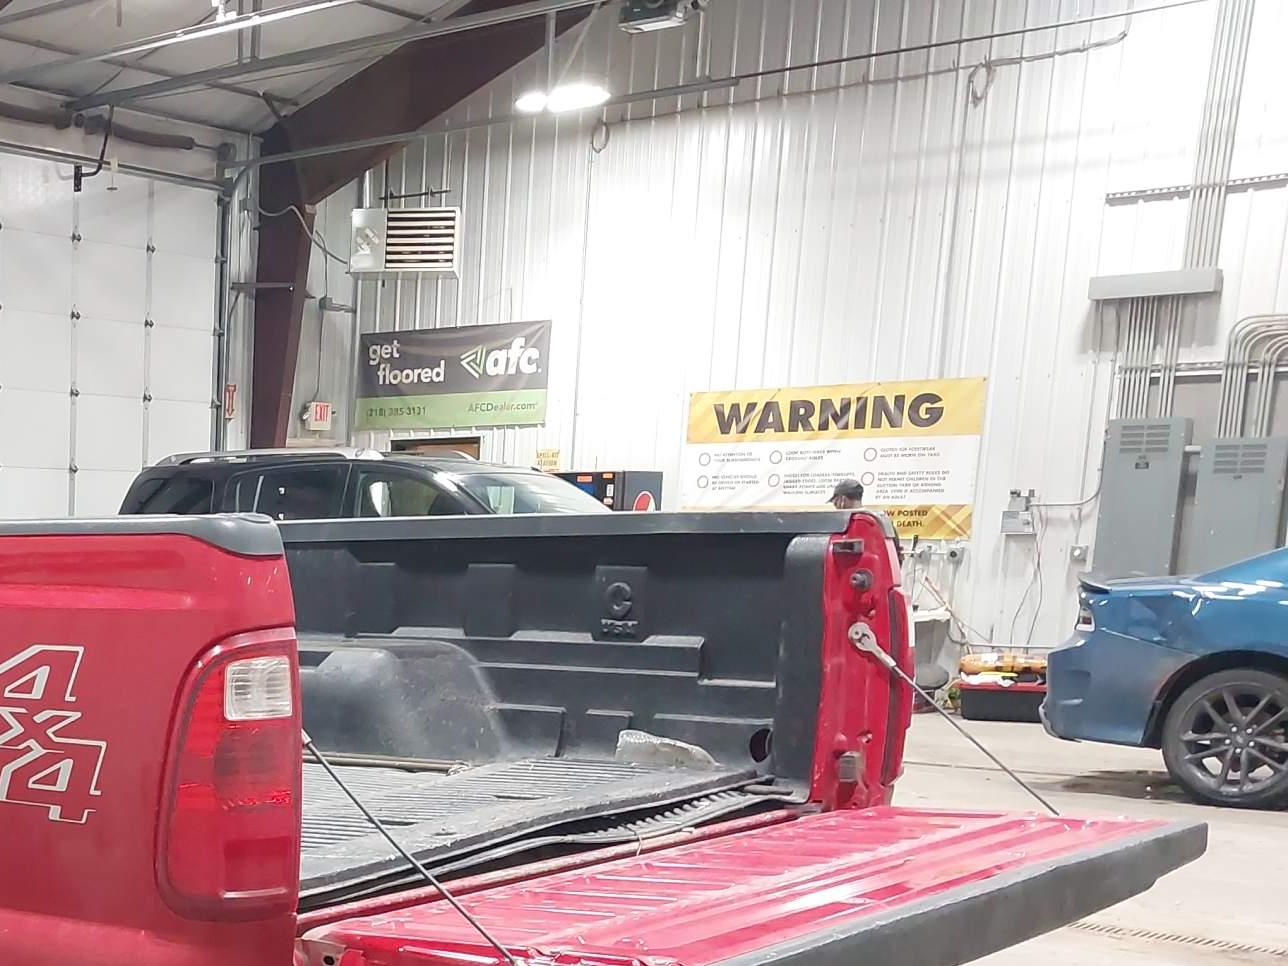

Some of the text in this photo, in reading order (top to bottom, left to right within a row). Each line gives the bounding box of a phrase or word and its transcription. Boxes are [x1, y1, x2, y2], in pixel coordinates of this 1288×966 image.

[368, 339, 400, 365] get
[377, 360, 445, 385] floored
[315, 404, 329, 422] EXIT
[713, 392, 944, 435] WARNING
[897, 509, 928, 517] POSTED
